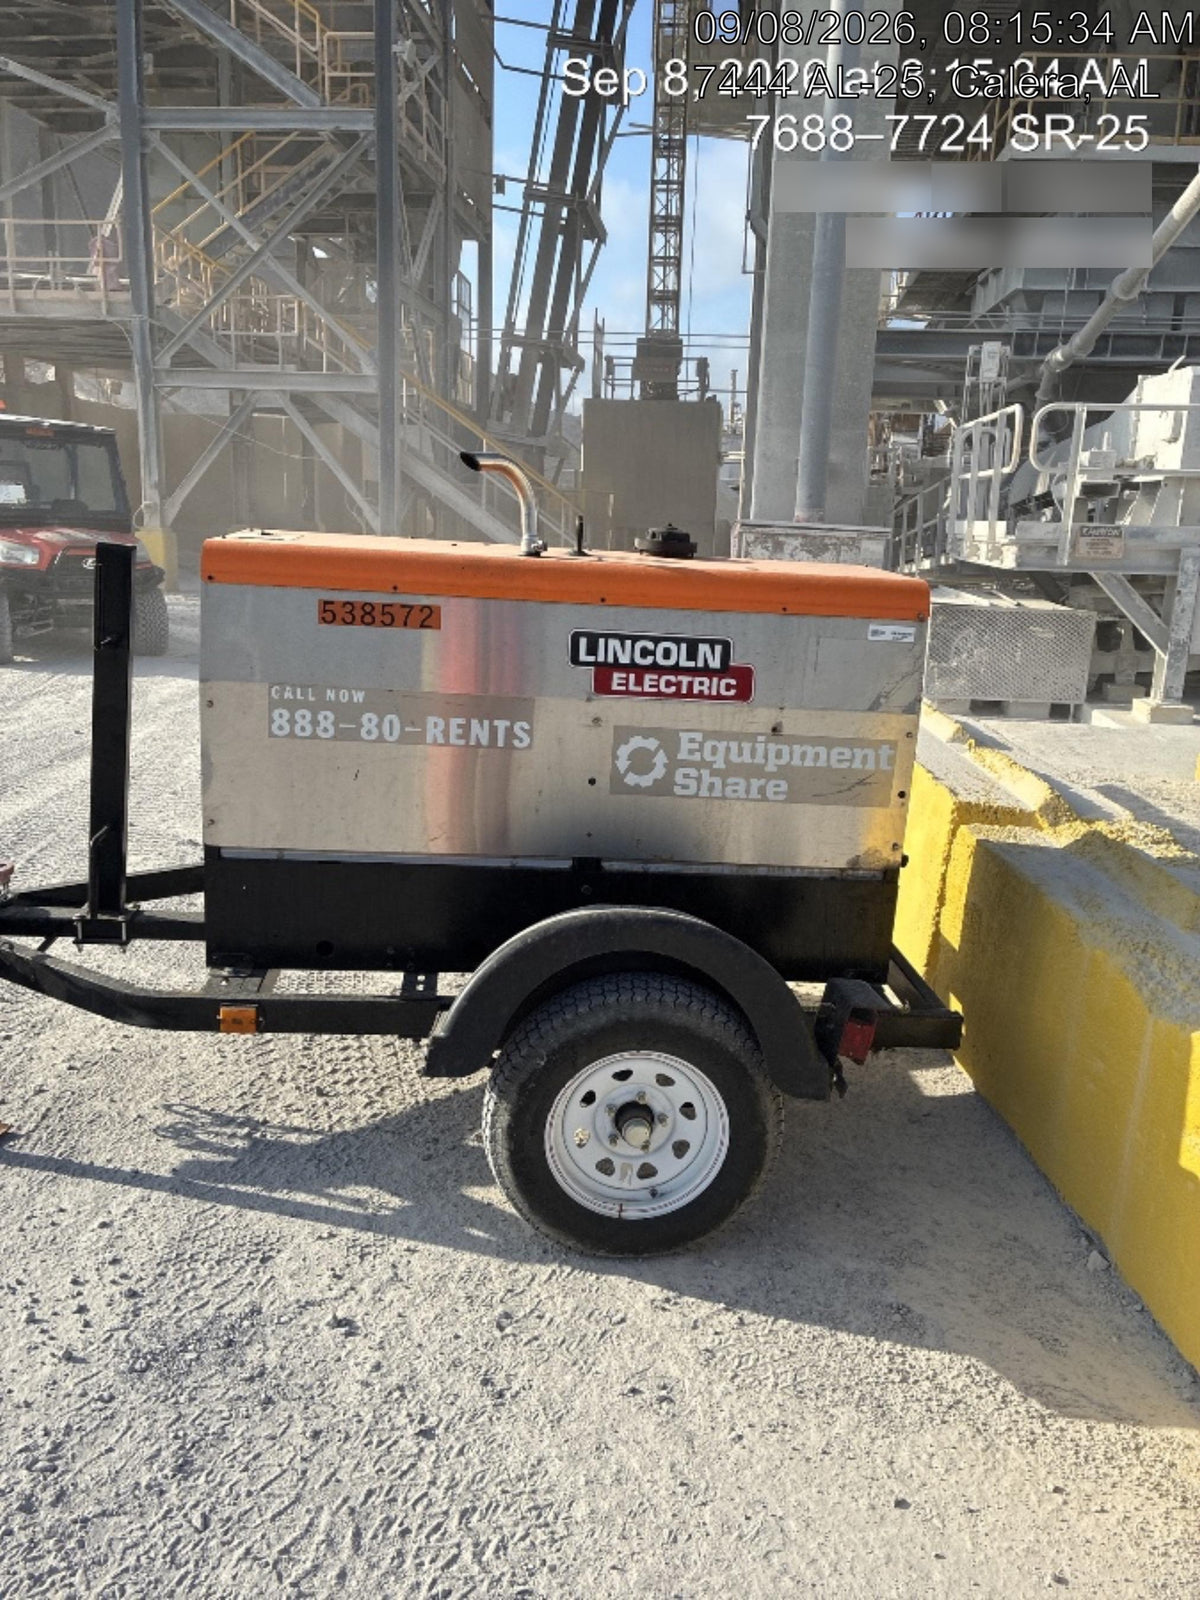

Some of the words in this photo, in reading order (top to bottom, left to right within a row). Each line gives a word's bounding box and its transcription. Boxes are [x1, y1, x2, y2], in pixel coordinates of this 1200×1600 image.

[320, 600, 434, 629] 538572
[578, 635, 723, 670] LINCOLN
[270, 685, 316, 702] CALL
[325, 688, 367, 703] NOW
[610, 671, 738, 697] ELECTRIC
[270, 707, 532, 749] 888-80-RENTS
[676, 731, 896, 773] Equipment
[673, 767, 789, 801] Share
